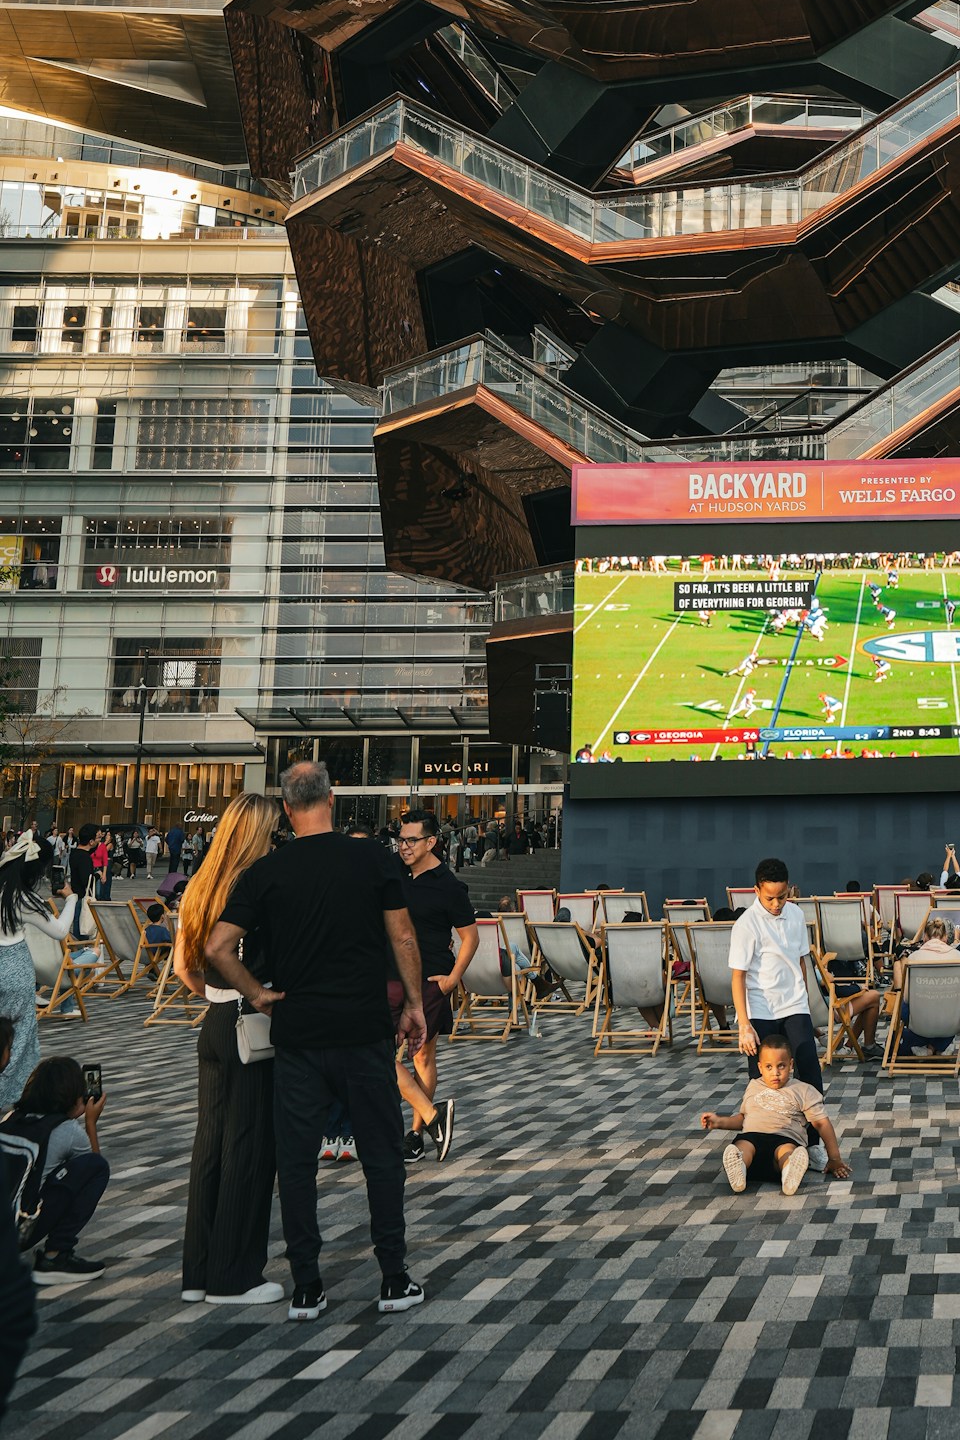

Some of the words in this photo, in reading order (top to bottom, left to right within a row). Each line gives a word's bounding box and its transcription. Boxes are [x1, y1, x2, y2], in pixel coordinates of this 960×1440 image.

[861, 476, 917, 485] PRESENTED
[919, 476, 932, 484] BY
[689, 472, 807, 500] BACKYARD
[839, 489, 896, 504] WELLS
[900, 488, 956, 503] FARGO
[689, 503, 704, 513] AT
[708, 501, 763, 513] HUDSON
[767, 500, 807, 512] YARDS
[126, 565, 217, 583] lululemon
[679, 584, 691, 594] SO
[692, 583, 711, 595] FAR,
[713, 583, 730, 594] IT'S
[732, 582, 754, 593] BEEN
[756, 582, 763, 593] A
[764, 582, 793, 593] LITTLE
[795, 581, 810, 592] BIT
[679, 598, 690, 609] OF
[692, 597, 744, 608] EVERYTHING
[747, 597, 764, 608] FOR
[766, 596, 806, 607] GEORGIA.
[817, 657, 837, 666] 10
[659, 731, 703, 739] GEORGIA
[743, 731, 757, 741] 26
[783, 728, 826, 737] FLORIDA
[877, 729, 885, 738] 7
[892, 729, 914, 738] 2ND
[918, 728, 941, 737] 8:43
[724, 735, 739, 743] 7-0
[183, 810, 219, 823] Cartier
